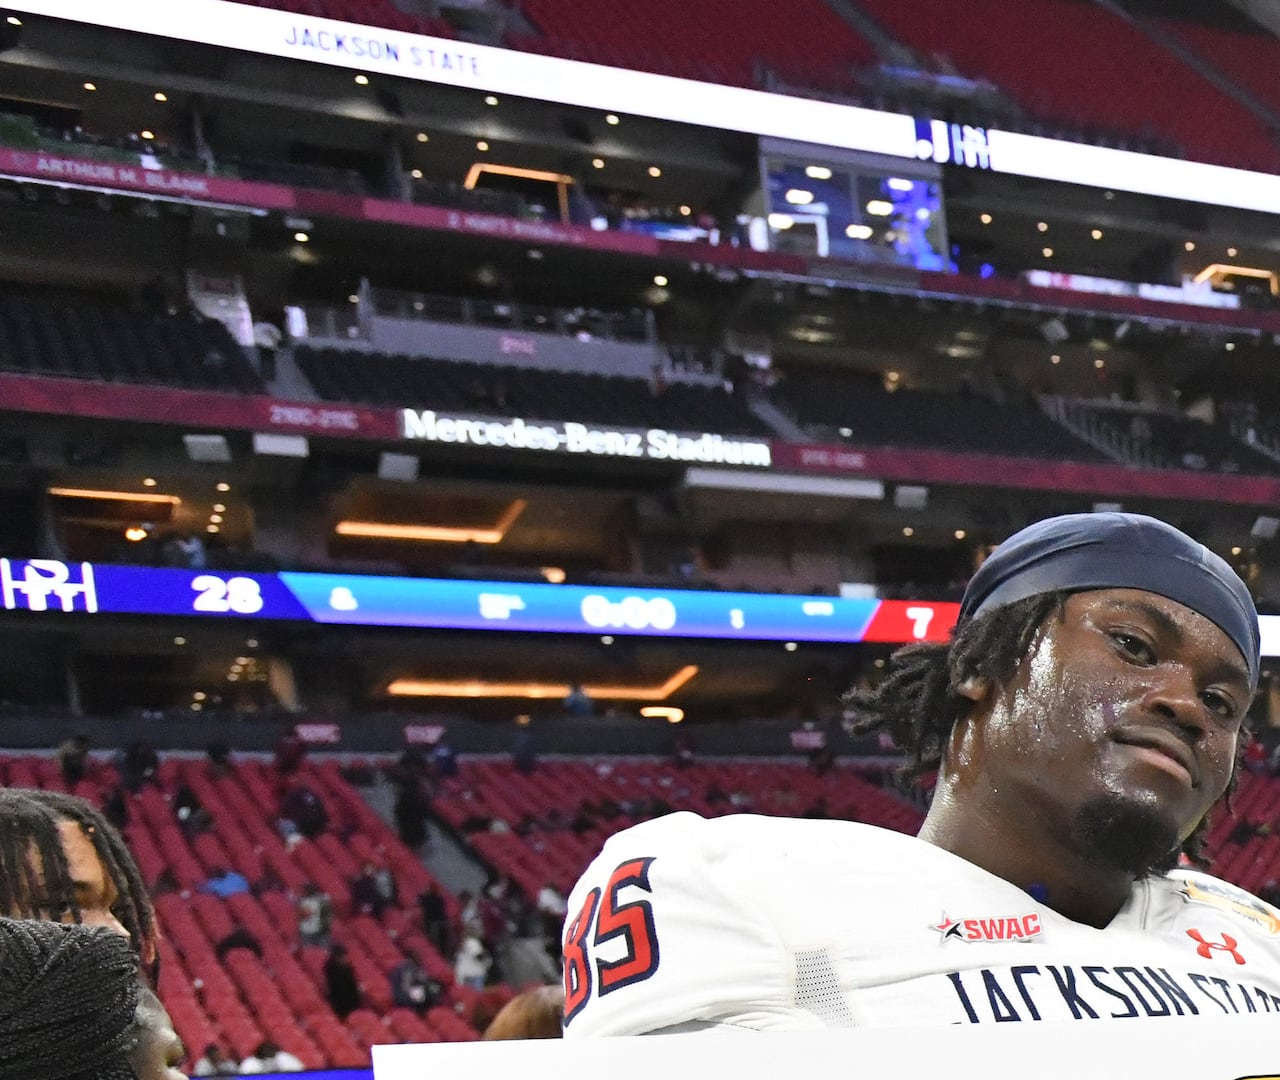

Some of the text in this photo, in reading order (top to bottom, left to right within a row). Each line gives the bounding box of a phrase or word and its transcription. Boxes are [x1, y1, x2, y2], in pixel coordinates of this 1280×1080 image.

[285, 27, 481, 76] JACKSON STATE
[403, 408, 643, 457] Mercedes-Benz
[647, 429, 772, 467] Stadium
[191, 575, 264, 614] 28
[906, 606, 935, 639] 7
[562, 856, 661, 1028] 85
[967, 914, 1041, 940] SWAC
